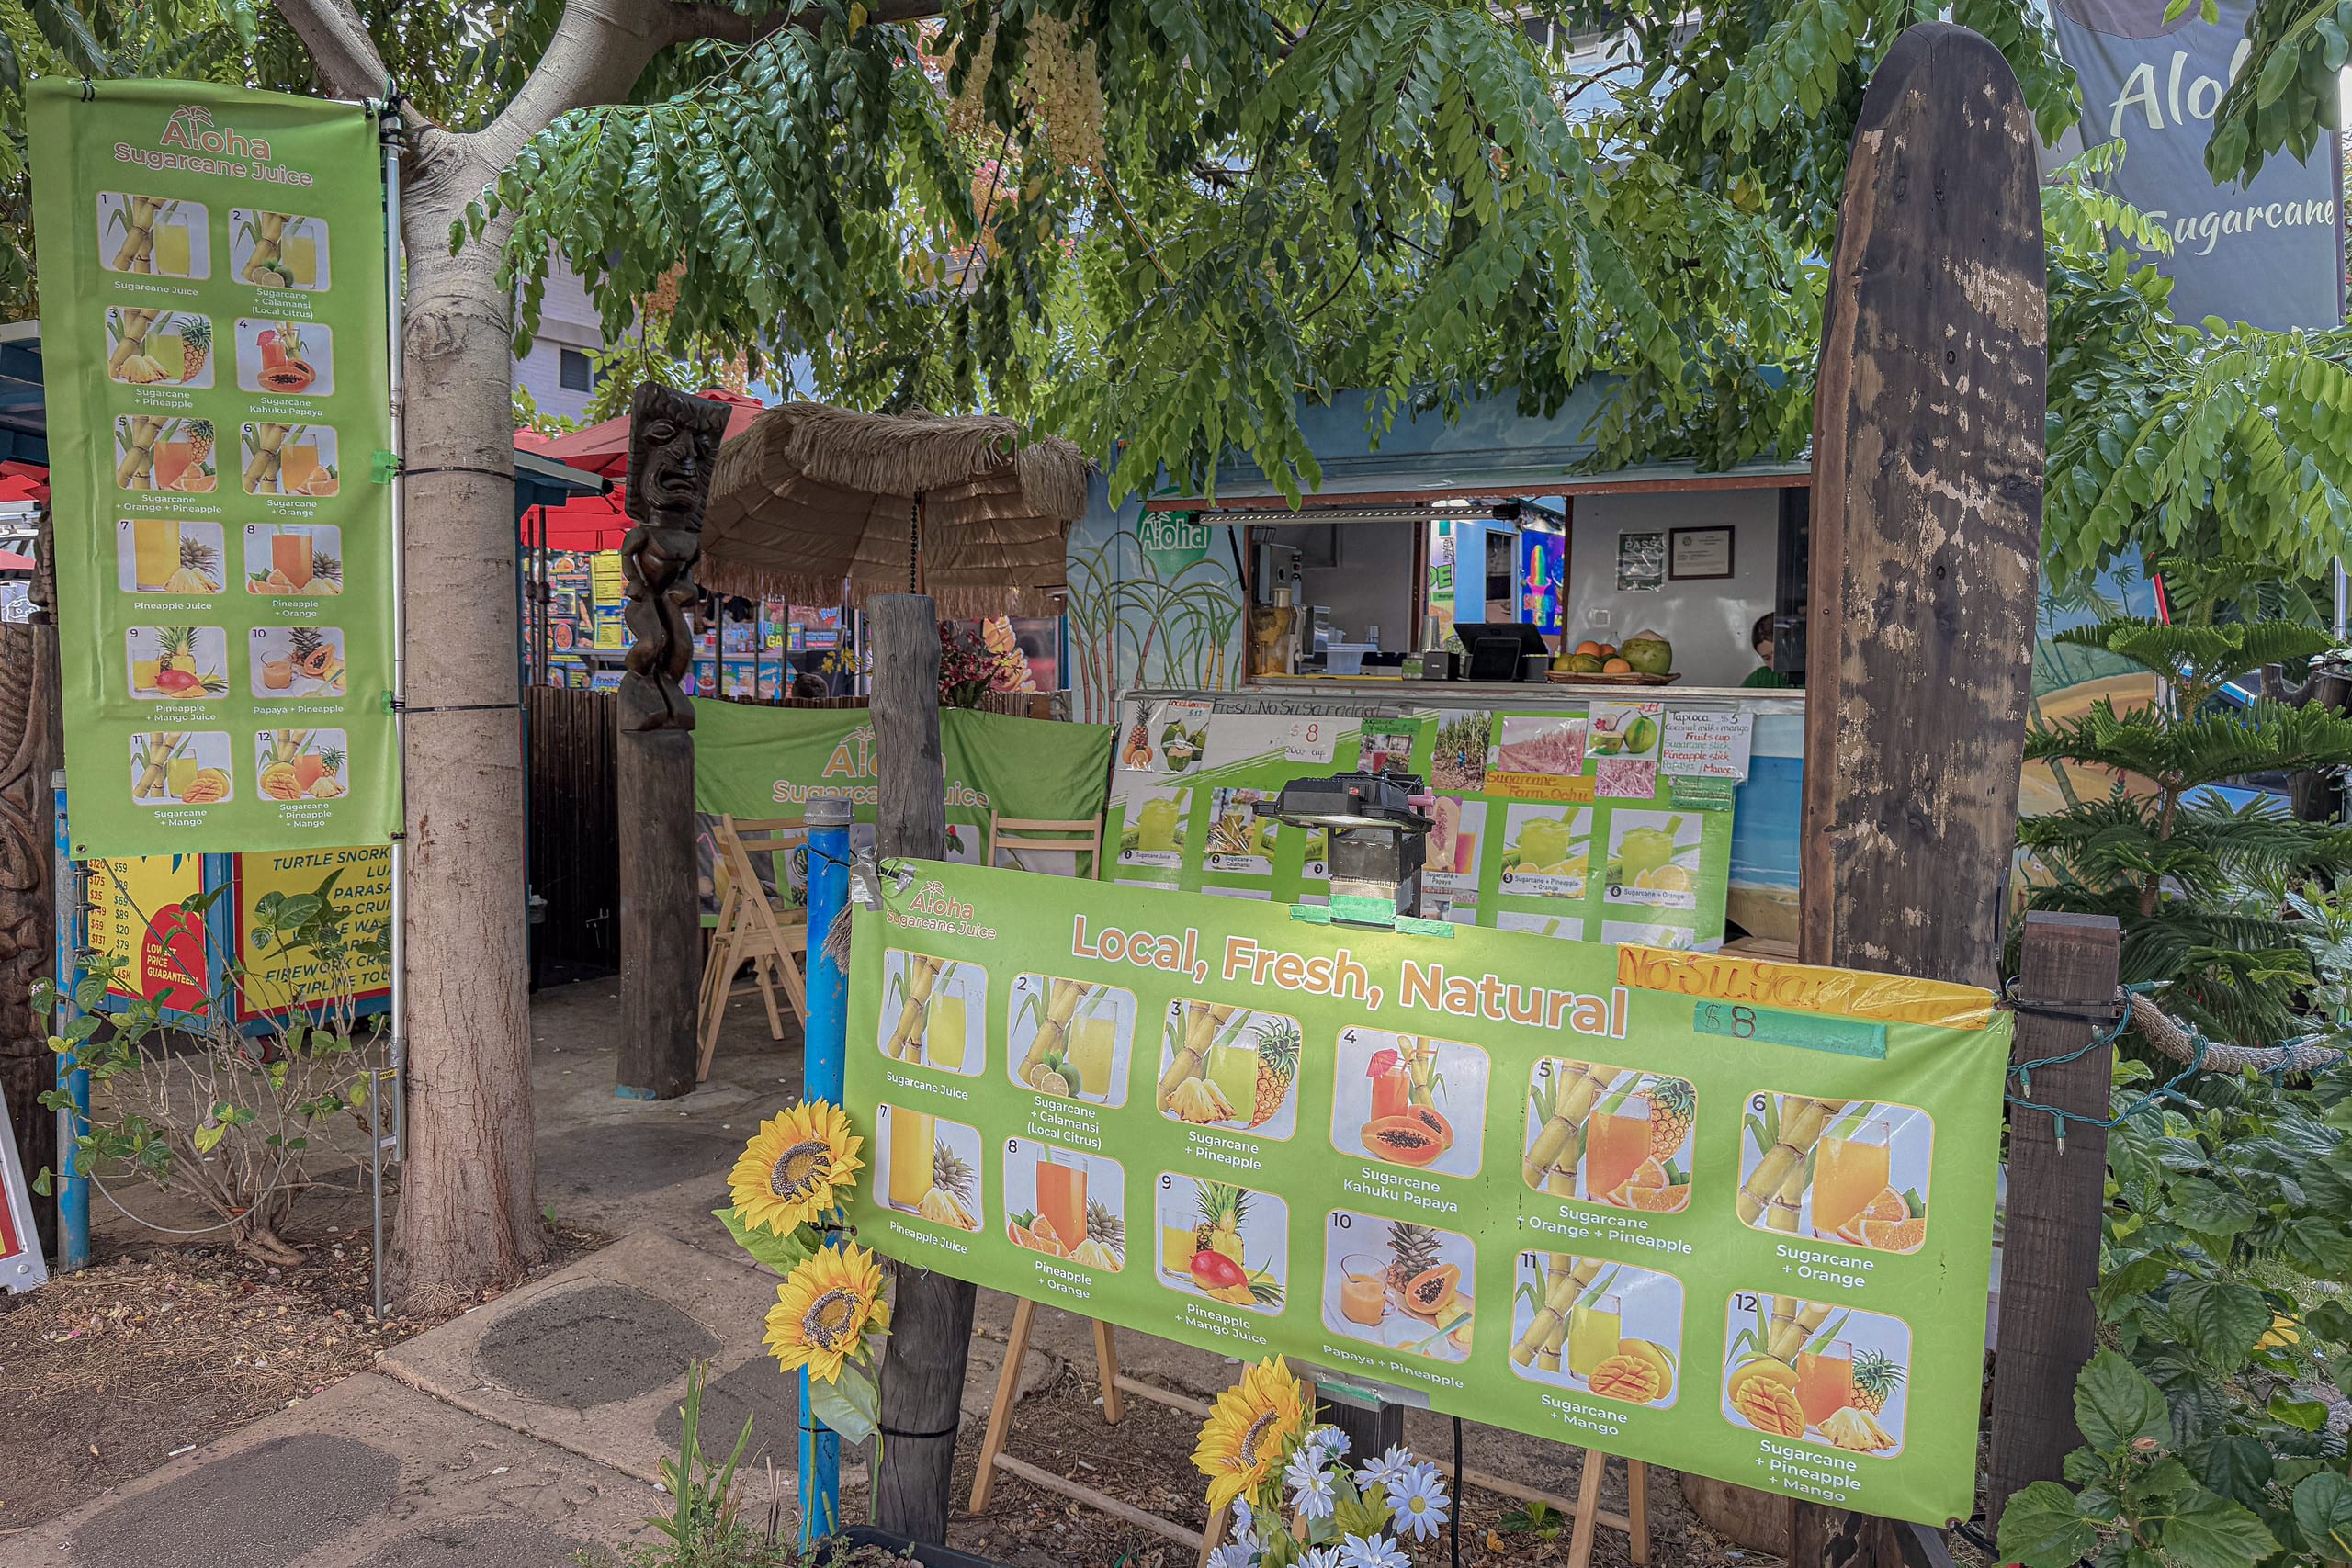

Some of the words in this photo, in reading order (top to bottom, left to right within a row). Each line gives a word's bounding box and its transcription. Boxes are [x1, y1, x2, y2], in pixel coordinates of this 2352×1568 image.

[2109, 38, 2252, 138] Alo
[160, 104, 271, 161] Aloha
[113, 141, 247, 178] Sugarcane
[251, 162, 313, 187] Juice
[101, 194, 107, 204] 1
[233, 210, 241, 220] 2
[114, 281, 170, 294] Sugarcane
[172, 287, 198, 296] Juice
[256, 288, 308, 299] Sugarcane
[262, 298, 311, 310] Calamansi
[109, 308, 118, 319] 3
[251, 307, 280, 317] (Local
[282, 309, 313, 320] Citrus)
[239, 320, 248, 329] 4
[135, 389, 191, 400] Sugarcane
[142, 398, 194, 409] Pineapple
[260, 397, 311, 408] Sugarcane
[249, 405, 287, 414] Kahuku
[288, 407, 323, 417] Papaya
[119, 416, 127, 426] 5
[244, 423, 253, 433] 6
[141, 494, 196, 505] Sugarcane
[266, 499, 318, 510] Sugarcane
[123, 503, 163, 513] Orange
[173, 505, 222, 514] Pineapple
[278, 508, 314, 517] Orange
[120, 521, 129, 530] 7
[247, 525, 255, 535] 8
[1140, 514, 1208, 550] Aloha
[133, 602, 184, 611] Pineapple
[186, 602, 212, 610] Juice
[272, 600, 319, 608] Pineapple
[282, 609, 317, 618] Orange
[130, 628, 138, 638] 9
[252, 629, 266, 638] 10
[156, 704, 205, 713] Pineapple
[253, 705, 288, 716] Papaya
[298, 705, 345, 715] Pineapple
[154, 714, 188, 722] Mango
[190, 713, 216, 722] Juice
[132, 735, 143, 744] 11
[258, 732, 271, 741] 12
[772, 780, 878, 805] Sugarca
[944, 781, 989, 808] uice
[153, 808, 207, 819] Sugarcane
[279, 801, 330, 812] Sugarcane
[286, 810, 332, 819] Pineapple
[168, 818, 203, 828] Mango
[293, 819, 325, 829] Mango
[273, 853, 333, 871] TURTLE
[336, 847, 391, 863] SNORK
[114, 862, 127, 873] $59
[89, 876, 105, 886] $175
[90, 889, 103, 900] $25
[909, 881, 975, 919] Aloha
[115, 909, 129, 920] $89
[91, 919, 104, 931] $69
[116, 924, 129, 935] $20
[886, 908, 956, 934] Sugarcane
[957, 921, 997, 942] Juice
[91, 934, 106, 945] $131
[116, 939, 129, 950] $79
[147, 955, 168, 968] PRICE
[1616, 946, 1671, 989] No
[117, 969, 131, 981] ASK
[1071, 914, 1210, 985] Local,
[1222, 935, 1385, 1012] Fresh,
[1398, 958, 1630, 1040] Natural
[1017, 976, 1028, 991] 2
[1171, 1001, 1182, 1017] 3
[1343, 1029, 1357, 1044] 4
[1539, 1060, 1552, 1077] 5
[887, 1071, 938, 1093] Sugarcane
[940, 1085, 969, 1100] Juice
[1035, 1095, 1096, 1119] Sugarcane
[1752, 1093, 1767, 1112] 6
[879, 1104, 888, 1118] 7
[1039, 1111, 1100, 1134] Calamansi
[1027, 1121, 1060, 1139] (Local
[1063, 1131, 1102, 1151] Citrus)
[1188, 1131, 1260, 1154] Sugarcane
[1008, 1139, 1018, 1153] 8
[1195, 1146, 1262, 1170] Pineapple
[1161, 1174, 1172, 1190] 9
[1362, 1167, 1441, 1192] Sugarcane
[1343, 1179, 1399, 1201] Kahuku
[1403, 1191, 1459, 1213] Papaya
[1331, 1212, 1352, 1229] 10
[1559, 1205, 1649, 1229] Sugarcane
[889, 1220, 938, 1245] Pineapple
[940, 1237, 968, 1254] Juice
[1529, 1216, 1589, 1238] Orange
[1609, 1229, 1692, 1255] Pineapple
[1521, 1252, 1537, 1269] 11
[1775, 1244, 1875, 1271] Sugarcane
[1035, 1260, 1092, 1286] Pineapple
[1797, 1265, 1866, 1288] Orange
[1047, 1279, 1091, 1300] Orange
[1735, 1293, 1758, 1313] 12
[1186, 1303, 1250, 1329] Pineapple
[1185, 1314, 1229, 1337] Mango
[1231, 1327, 1267, 1345] Juice
[1323, 1344, 1375, 1366] Papaya
[1390, 1361, 1464, 1388] Pineapple
[1541, 1394, 1628, 1423] Sugarcane
[1564, 1413, 1619, 1435] Mango
[1760, 1439, 1857, 1472] Sugarcane
[1770, 1459, 1861, 1490] Pineapple
[1783, 1478, 1846, 1503] Mango
